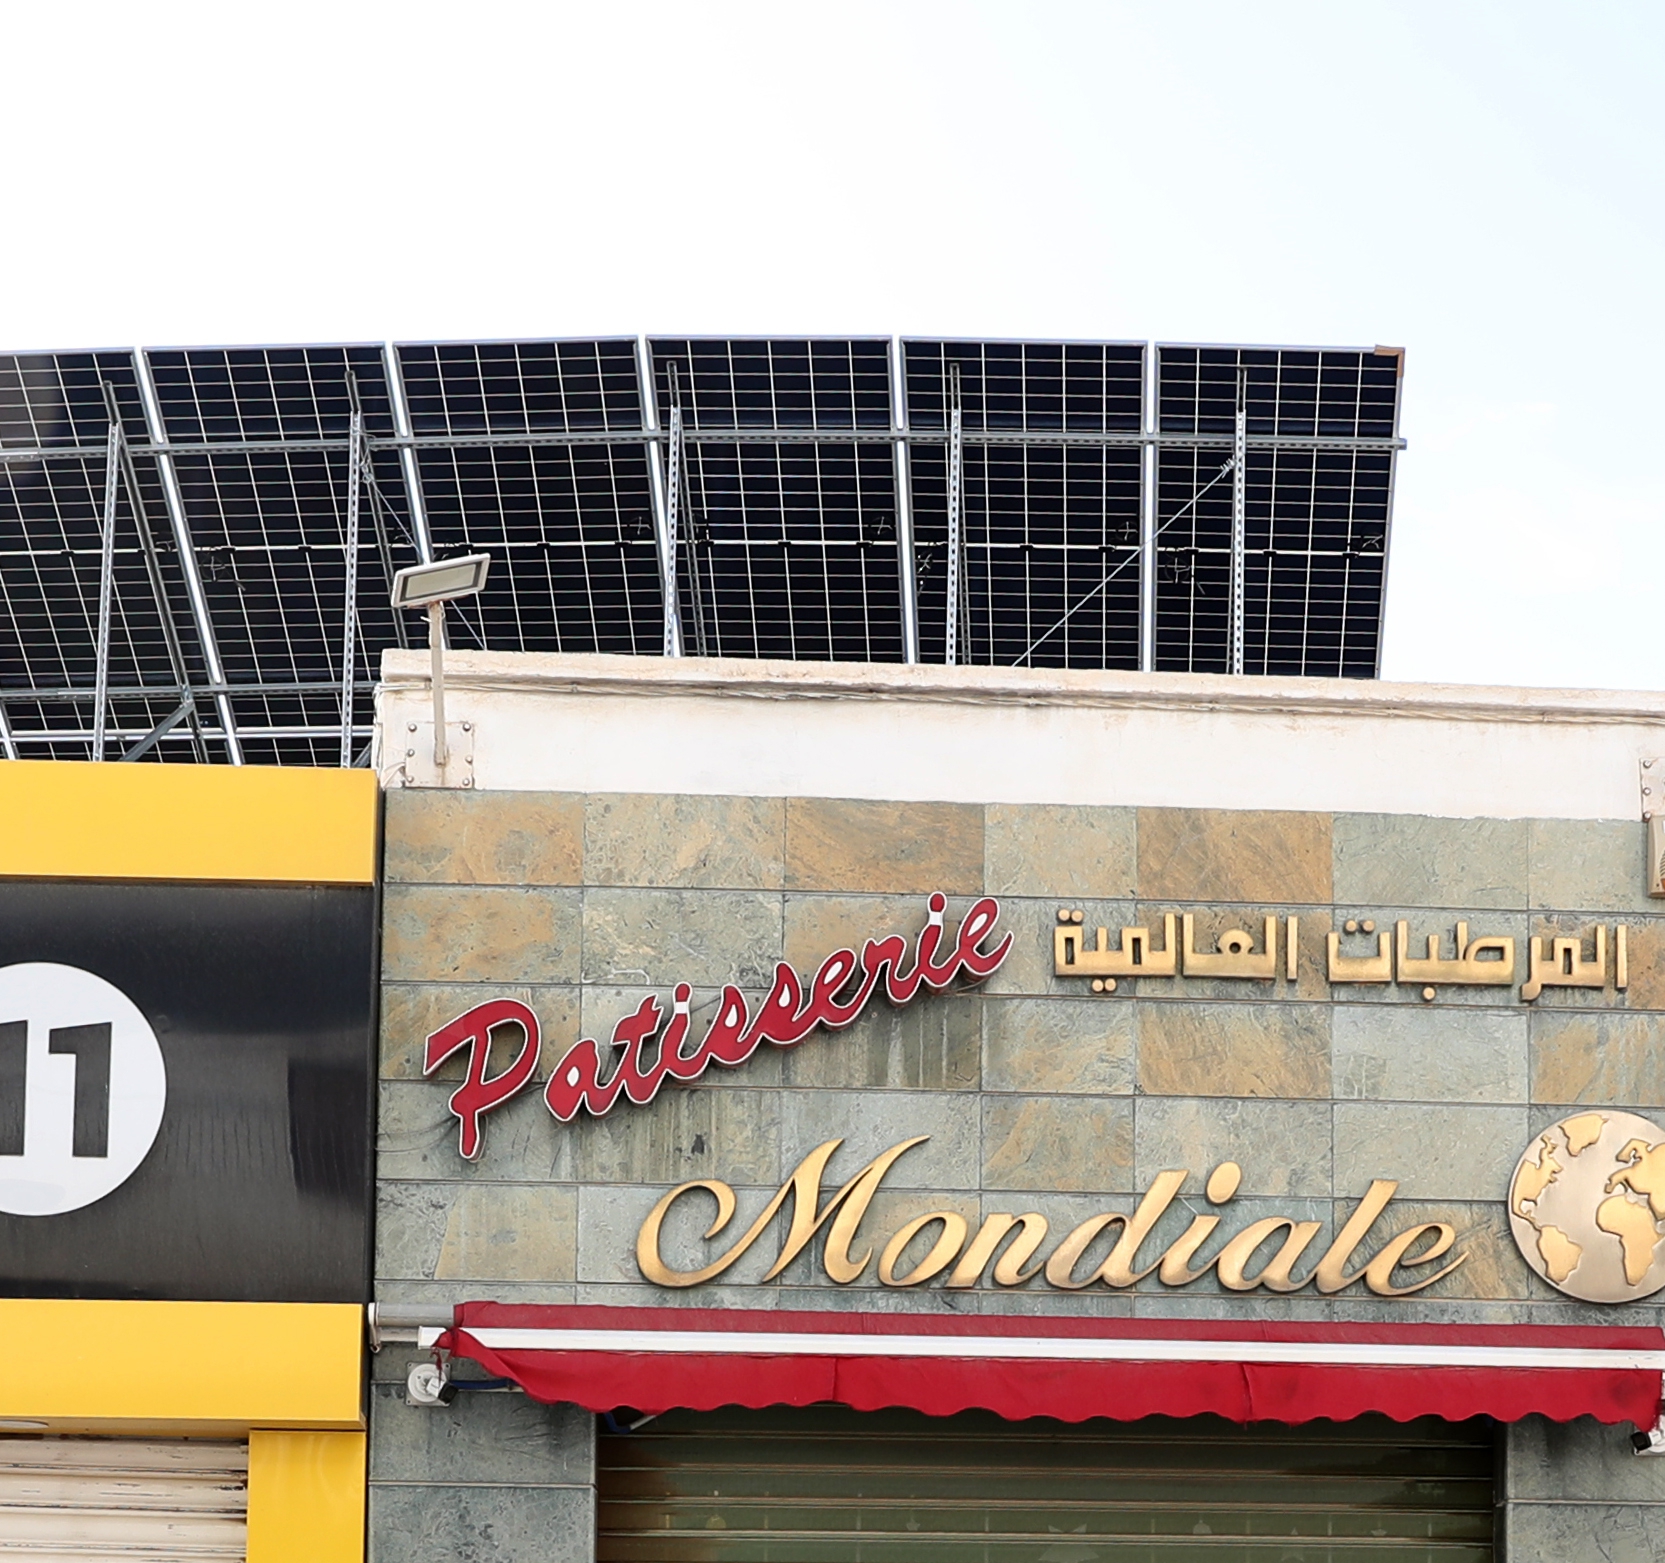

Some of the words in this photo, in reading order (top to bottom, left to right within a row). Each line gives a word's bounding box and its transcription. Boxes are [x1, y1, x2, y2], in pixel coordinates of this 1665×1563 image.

[1055, 908, 1298, 993] العالمية
[1328, 919, 1627, 1001] المرطبات
[422, 892, 1014, 1162] Patisserie
[633, 1134, 1473, 1296] Mondiale
